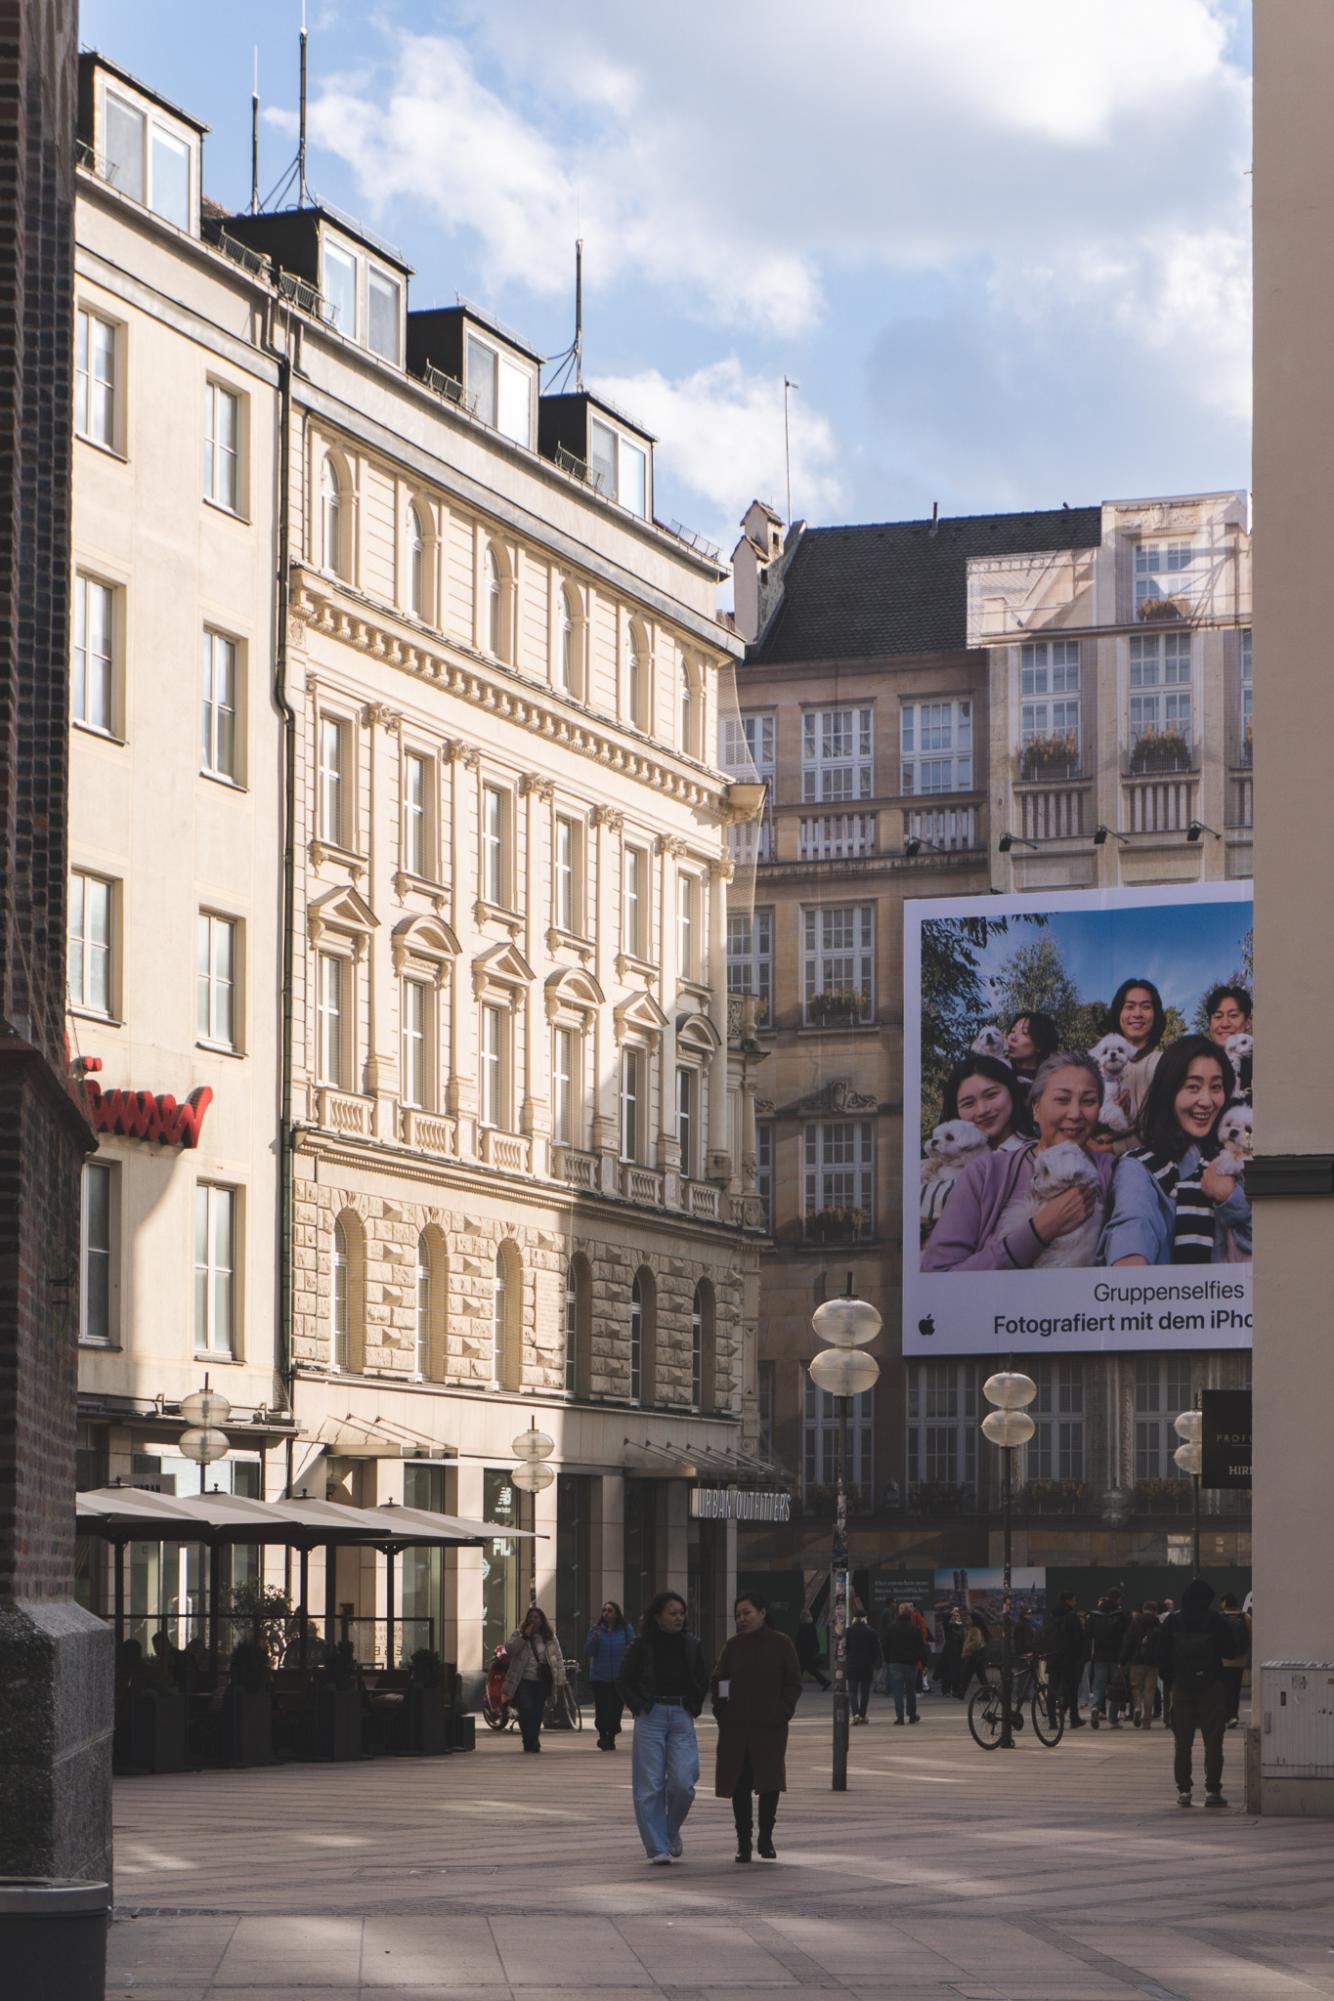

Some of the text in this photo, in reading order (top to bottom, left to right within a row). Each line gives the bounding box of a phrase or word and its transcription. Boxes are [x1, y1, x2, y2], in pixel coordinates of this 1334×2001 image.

[1094, 1281, 1244, 1305] Gruppenselfies
[994, 1313, 1115, 1337] Fotografiert
[1120, 1312, 1153, 1331] mit
[1159, 1311, 1205, 1330] dem
[1228, 1465, 1252, 1476] HIR
[699, 1488, 791, 1522] URBAN OUTFITTERS
